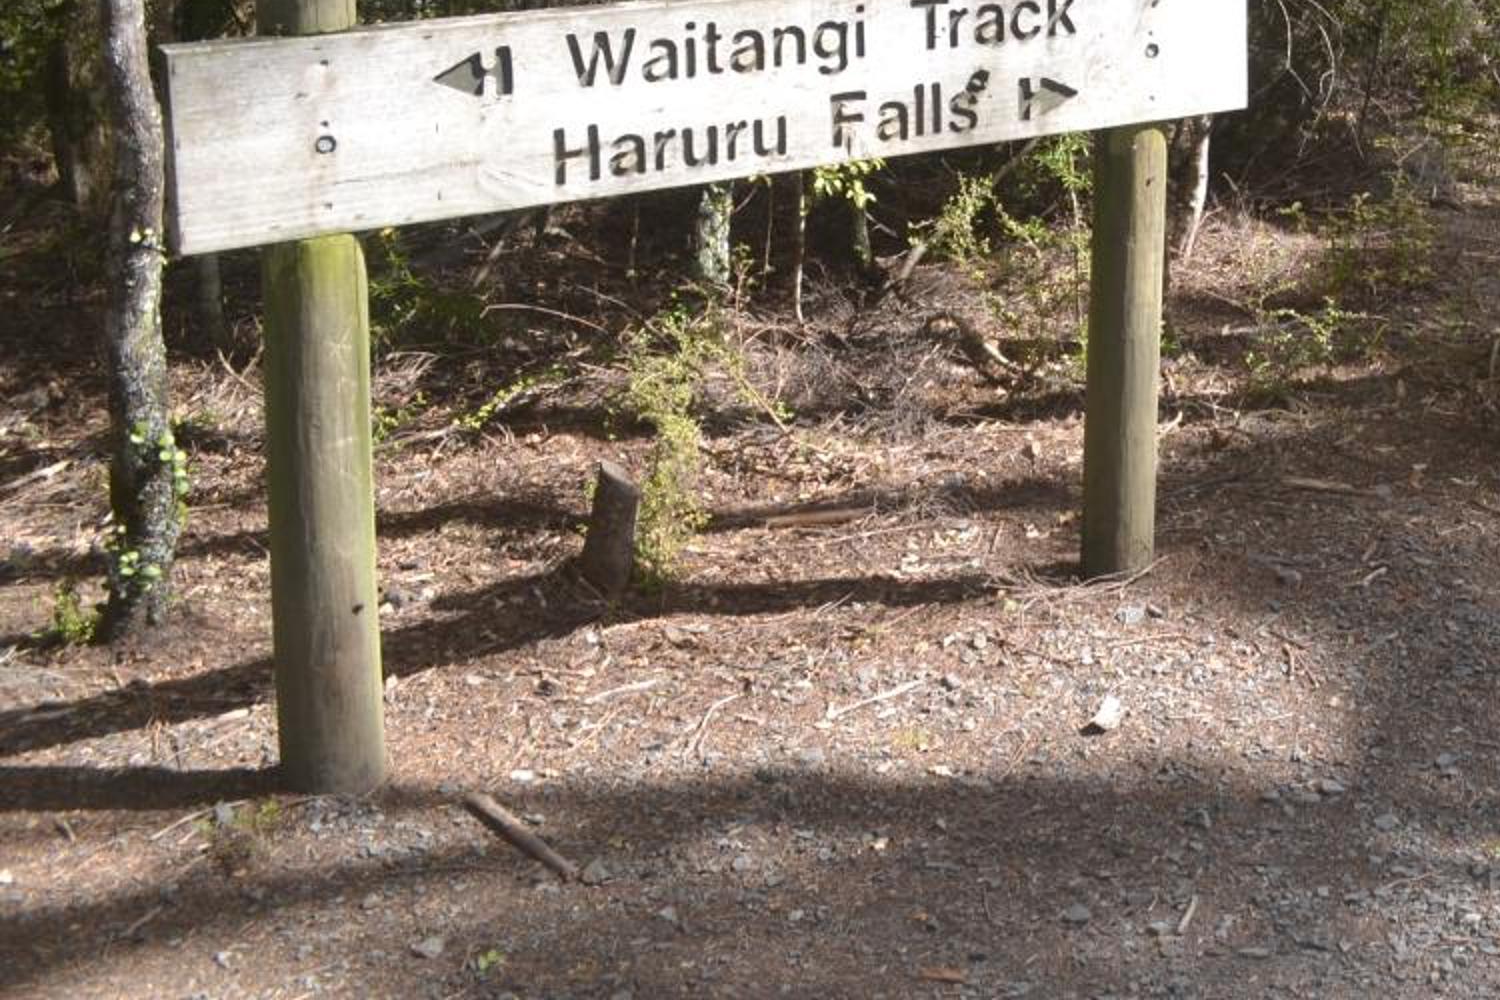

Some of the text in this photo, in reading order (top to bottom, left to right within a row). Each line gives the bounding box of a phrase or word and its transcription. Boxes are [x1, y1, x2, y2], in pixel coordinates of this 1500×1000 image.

[565, 4, 866, 88] Waitangi
[553, 81, 978, 185] Haruru Falls
